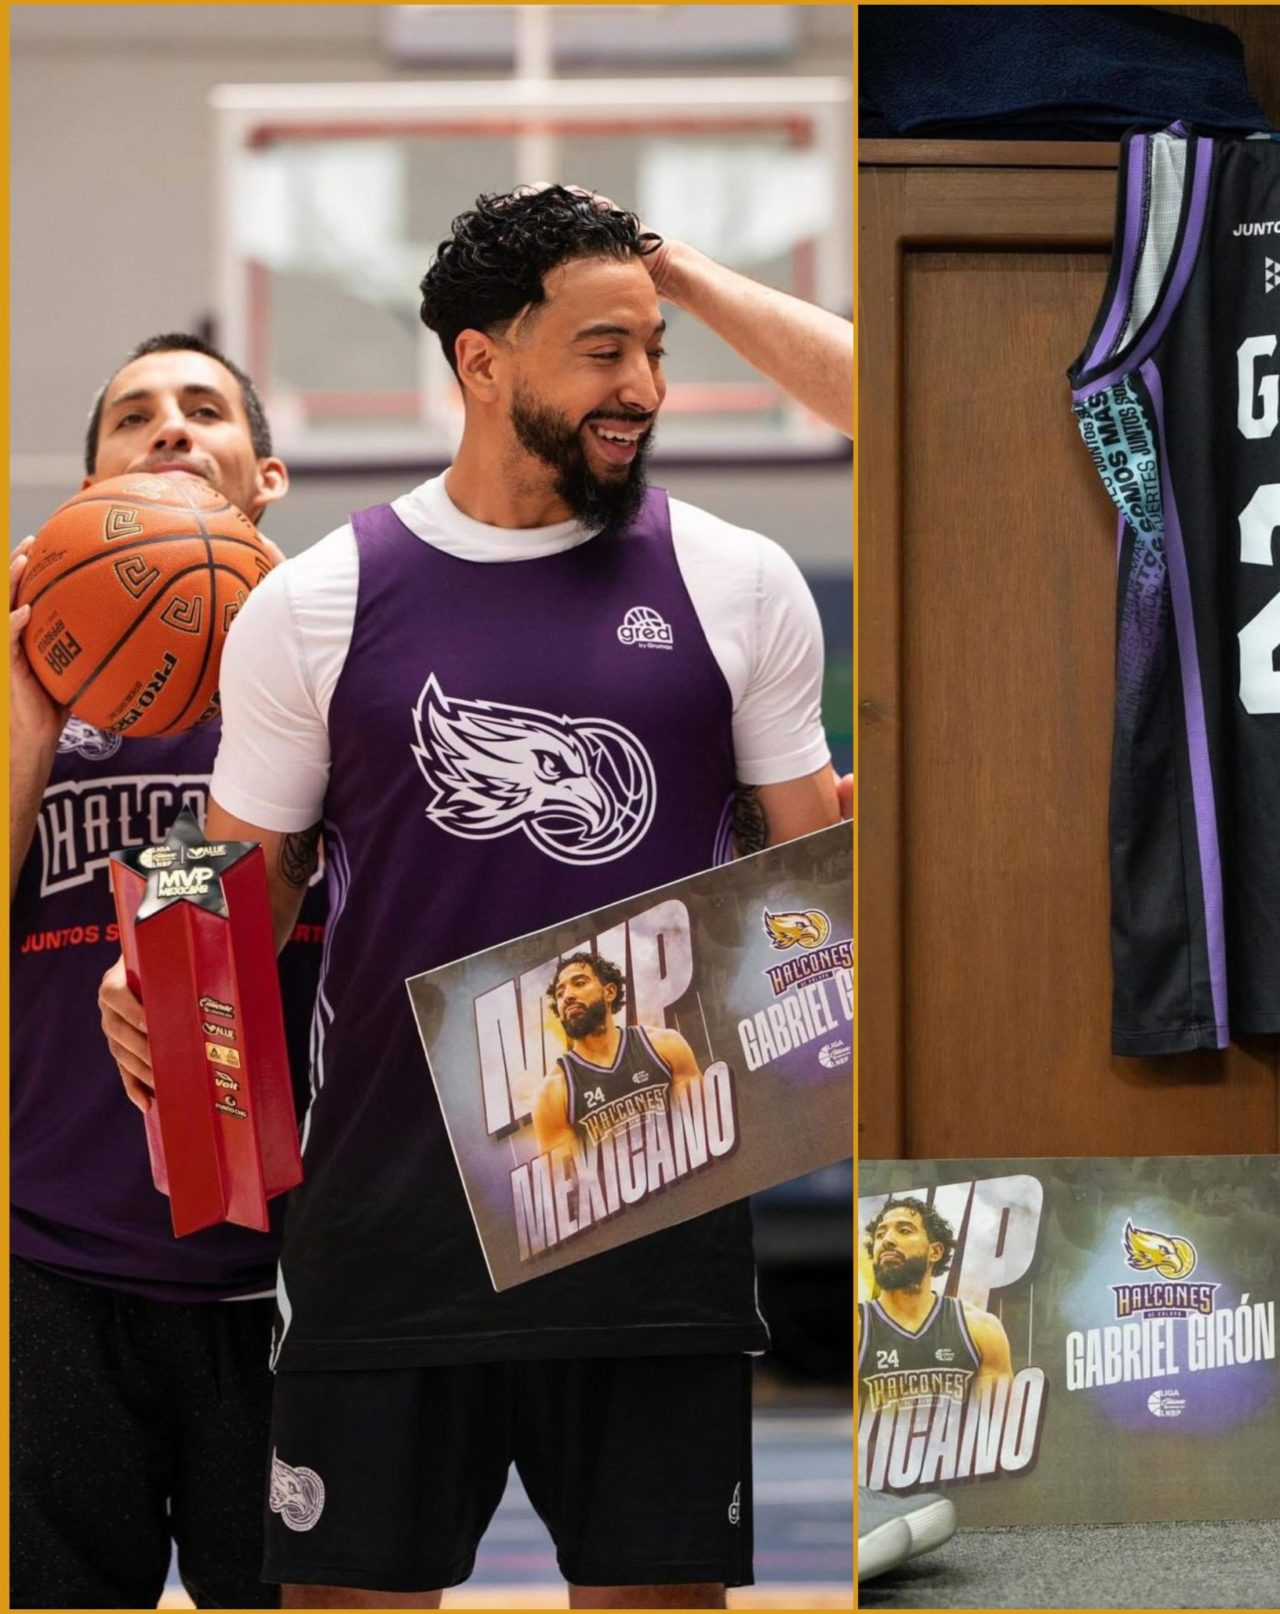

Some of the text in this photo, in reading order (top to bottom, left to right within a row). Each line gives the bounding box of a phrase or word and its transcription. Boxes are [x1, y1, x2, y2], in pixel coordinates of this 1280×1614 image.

[1119, 406, 1152, 456] JUNTOS
[45, 630, 83, 677] FIBA
[620, 626, 671, 643] gred
[46, 788, 208, 877] HALCO
[159, 867, 214, 888] MVP
[21, 925, 99, 953] JUNTOS
[770, 941, 852, 993] HALCONES
[737, 982, 839, 1072] GABRIEL
[215, 1078, 239, 1091] Voit
[584, 1086, 606, 1109] 24
[586, 1088, 667, 1141] HALCONES
[510, 1060, 737, 1263] MEXICANO
[1117, 1284, 1213, 1317] HALCONES
[876, 1349, 900, 1369] 24
[1065, 1292, 1276, 1392] GABRIEL GIRÓN
[873, 1372, 965, 1407] HALCONES
